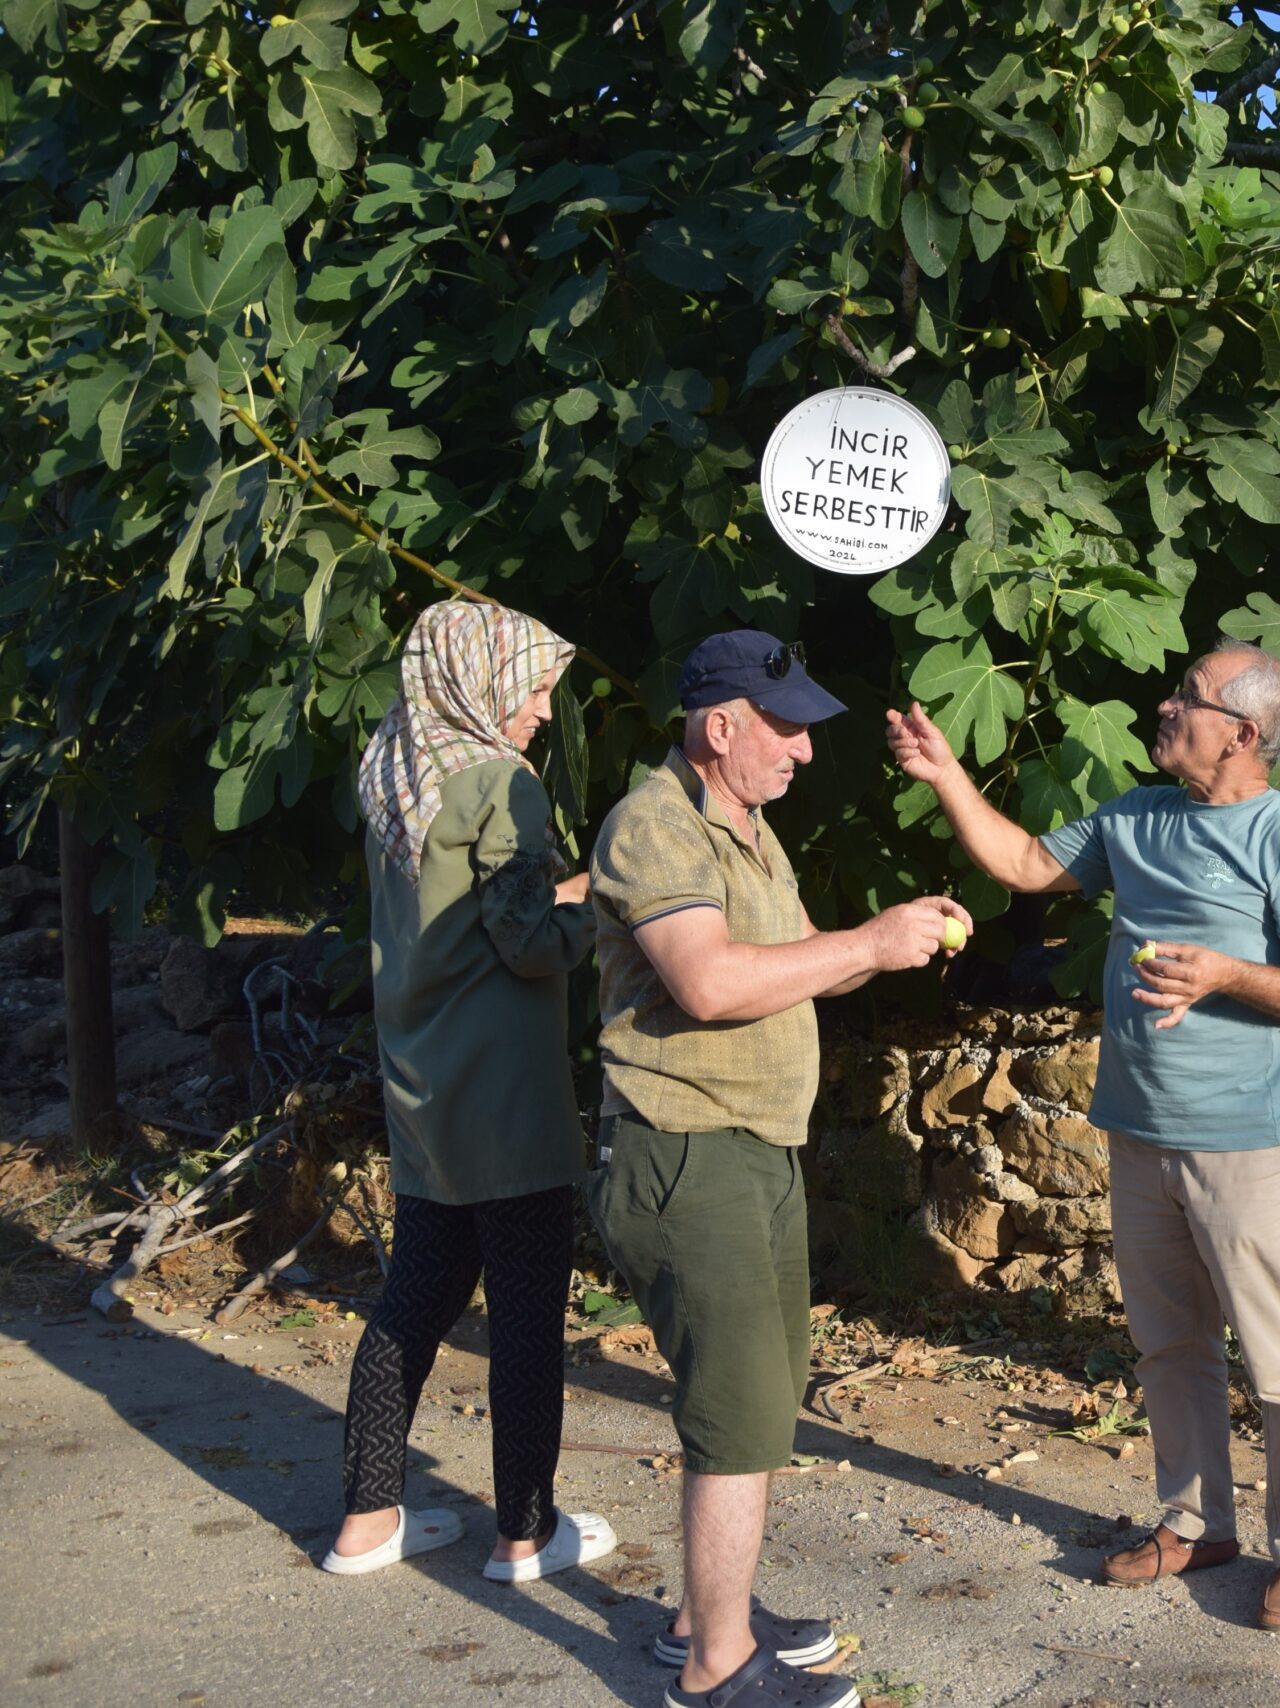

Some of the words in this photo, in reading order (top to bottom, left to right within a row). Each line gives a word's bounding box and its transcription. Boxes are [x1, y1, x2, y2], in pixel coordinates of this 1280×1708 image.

[830, 420, 909, 460] İNCİR
[805, 456, 909, 495] YEMEK
[780, 490, 929, 533] SERBESTTİR
